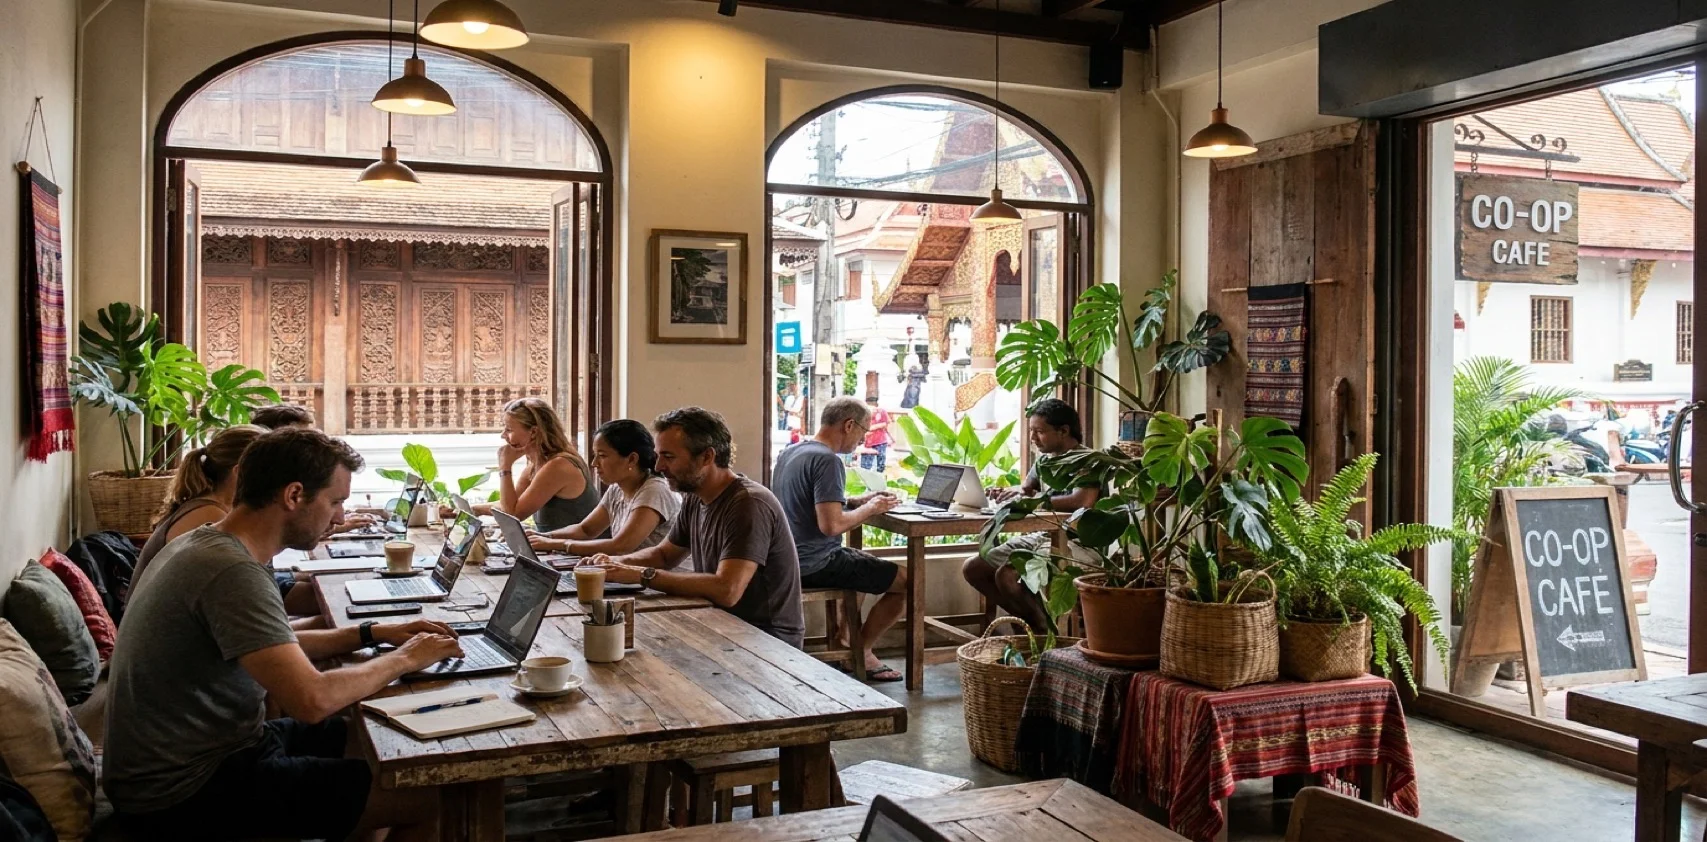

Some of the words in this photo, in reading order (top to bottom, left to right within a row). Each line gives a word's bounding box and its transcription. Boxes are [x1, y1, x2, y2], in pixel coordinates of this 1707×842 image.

[1471, 194, 1573, 233] CO-OP
[1492, 239, 1550, 266] CAFE
[1525, 527, 1609, 567] CO-OP
